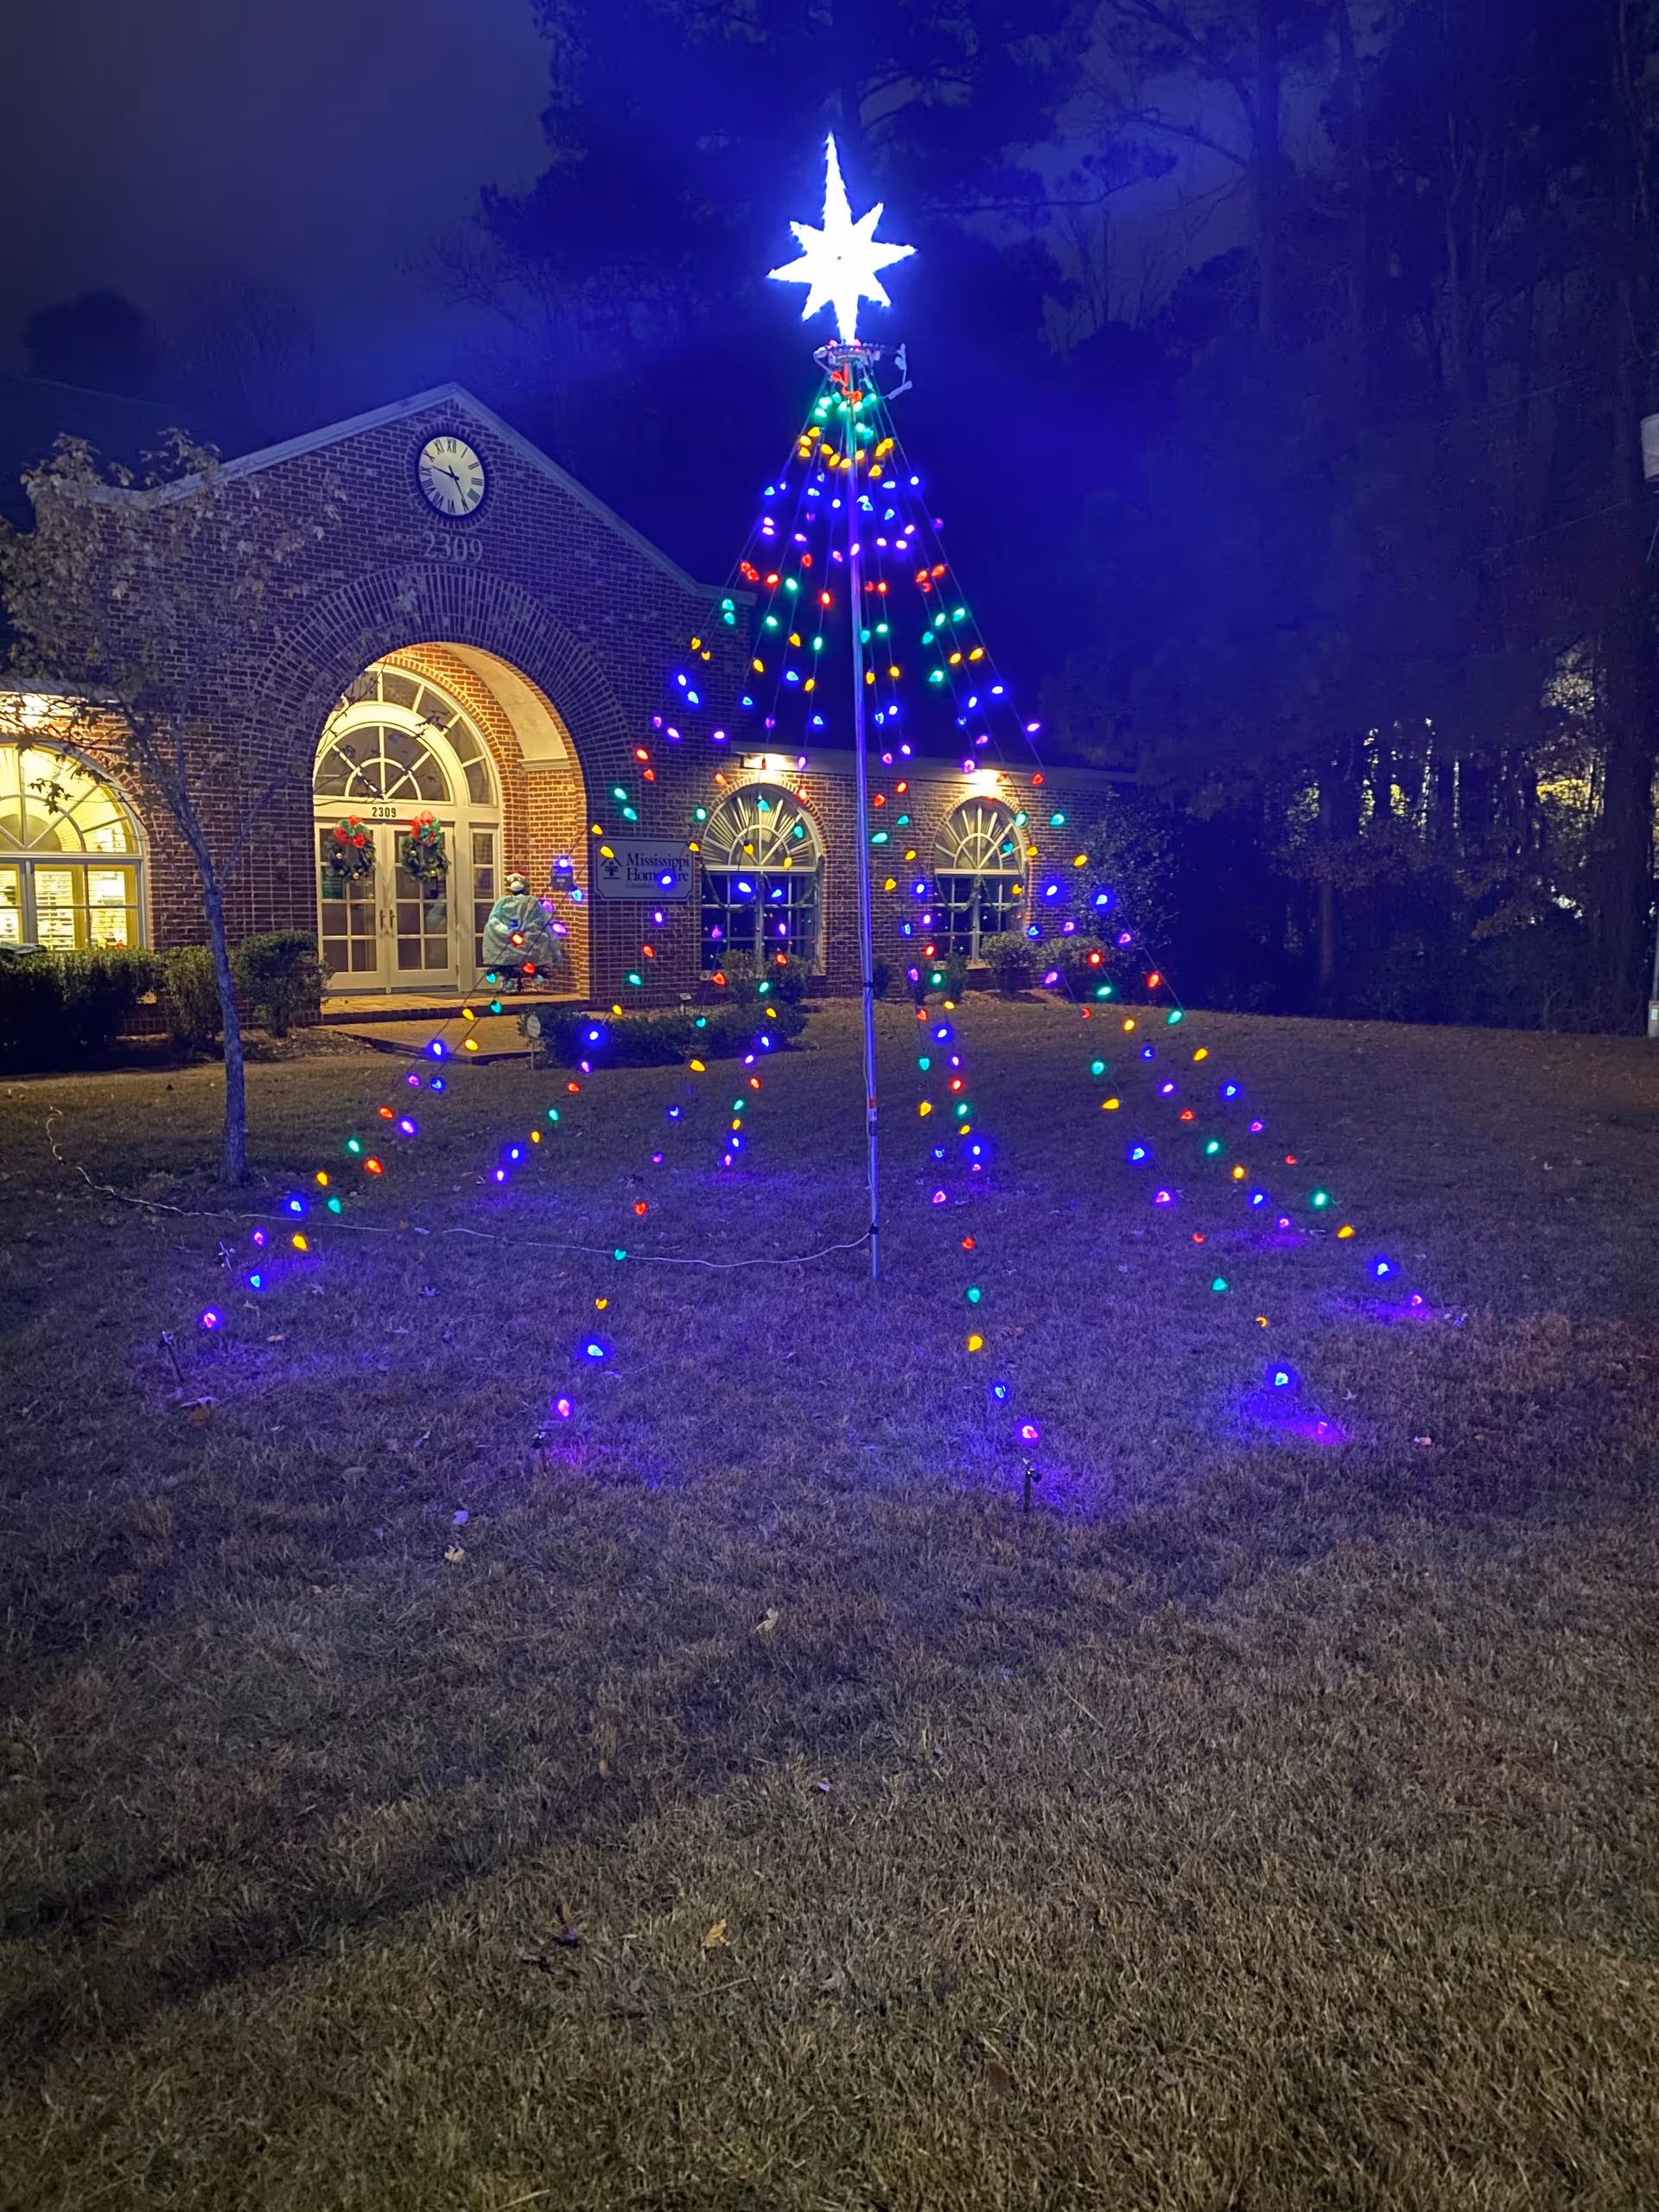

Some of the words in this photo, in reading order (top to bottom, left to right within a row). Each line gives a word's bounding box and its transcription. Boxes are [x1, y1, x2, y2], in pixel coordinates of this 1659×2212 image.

[423, 531, 483, 563] 2309
[372, 806, 397, 817] 2309
[626, 852, 690, 871] Mississippi
[626, 868, 689, 882] Homare
